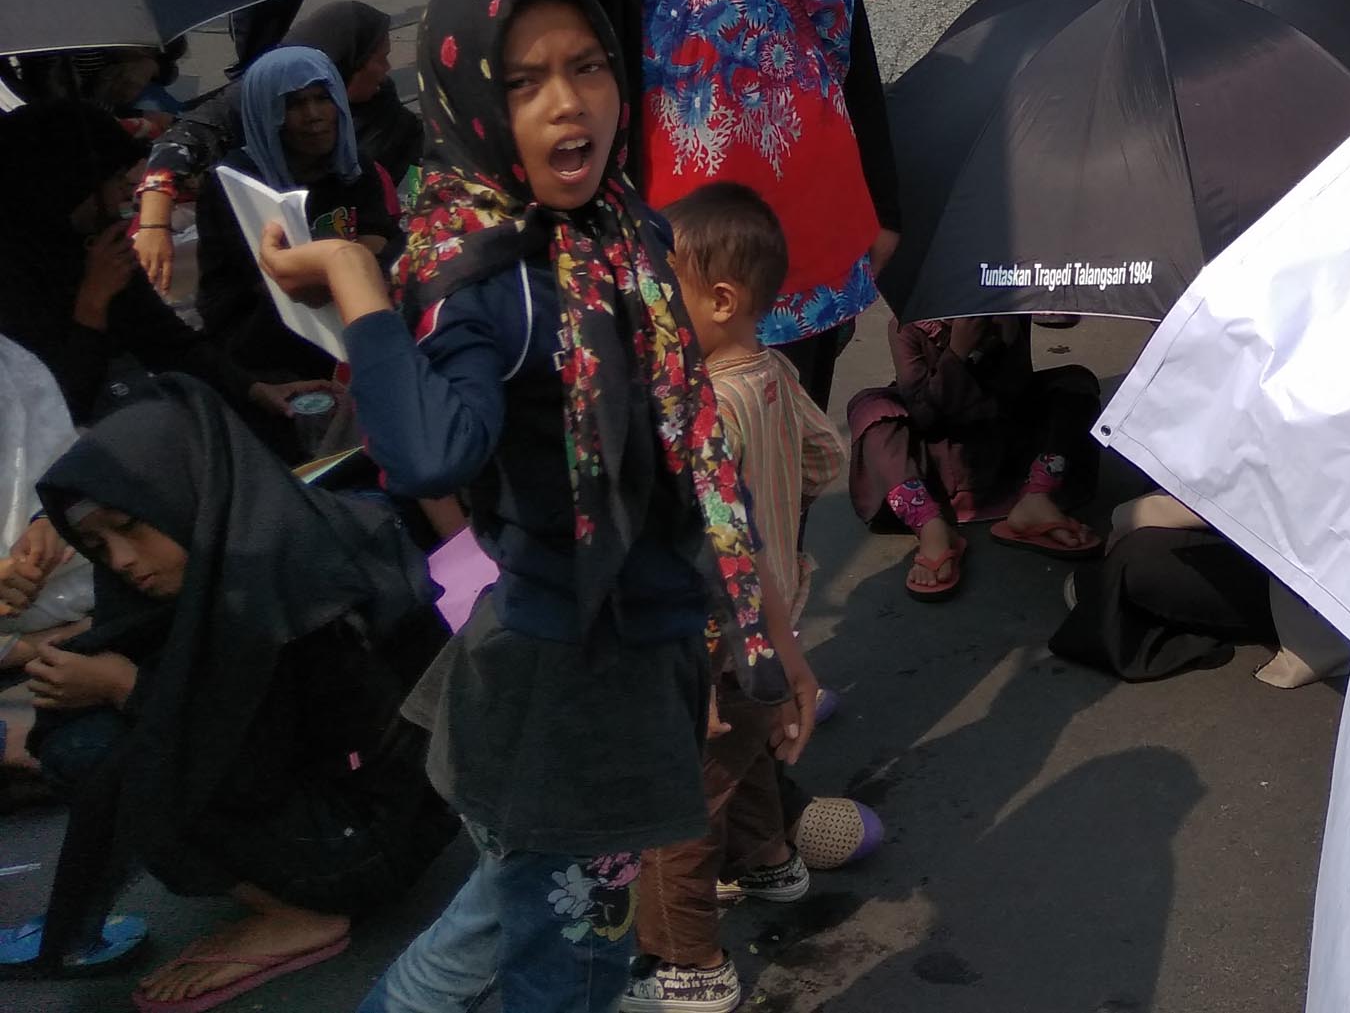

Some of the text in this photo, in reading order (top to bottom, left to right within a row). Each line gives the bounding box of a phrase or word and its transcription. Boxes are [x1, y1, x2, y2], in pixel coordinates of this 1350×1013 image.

[980, 261, 1153, 292] Tuntaskan Tragedi Talangsari 1984
